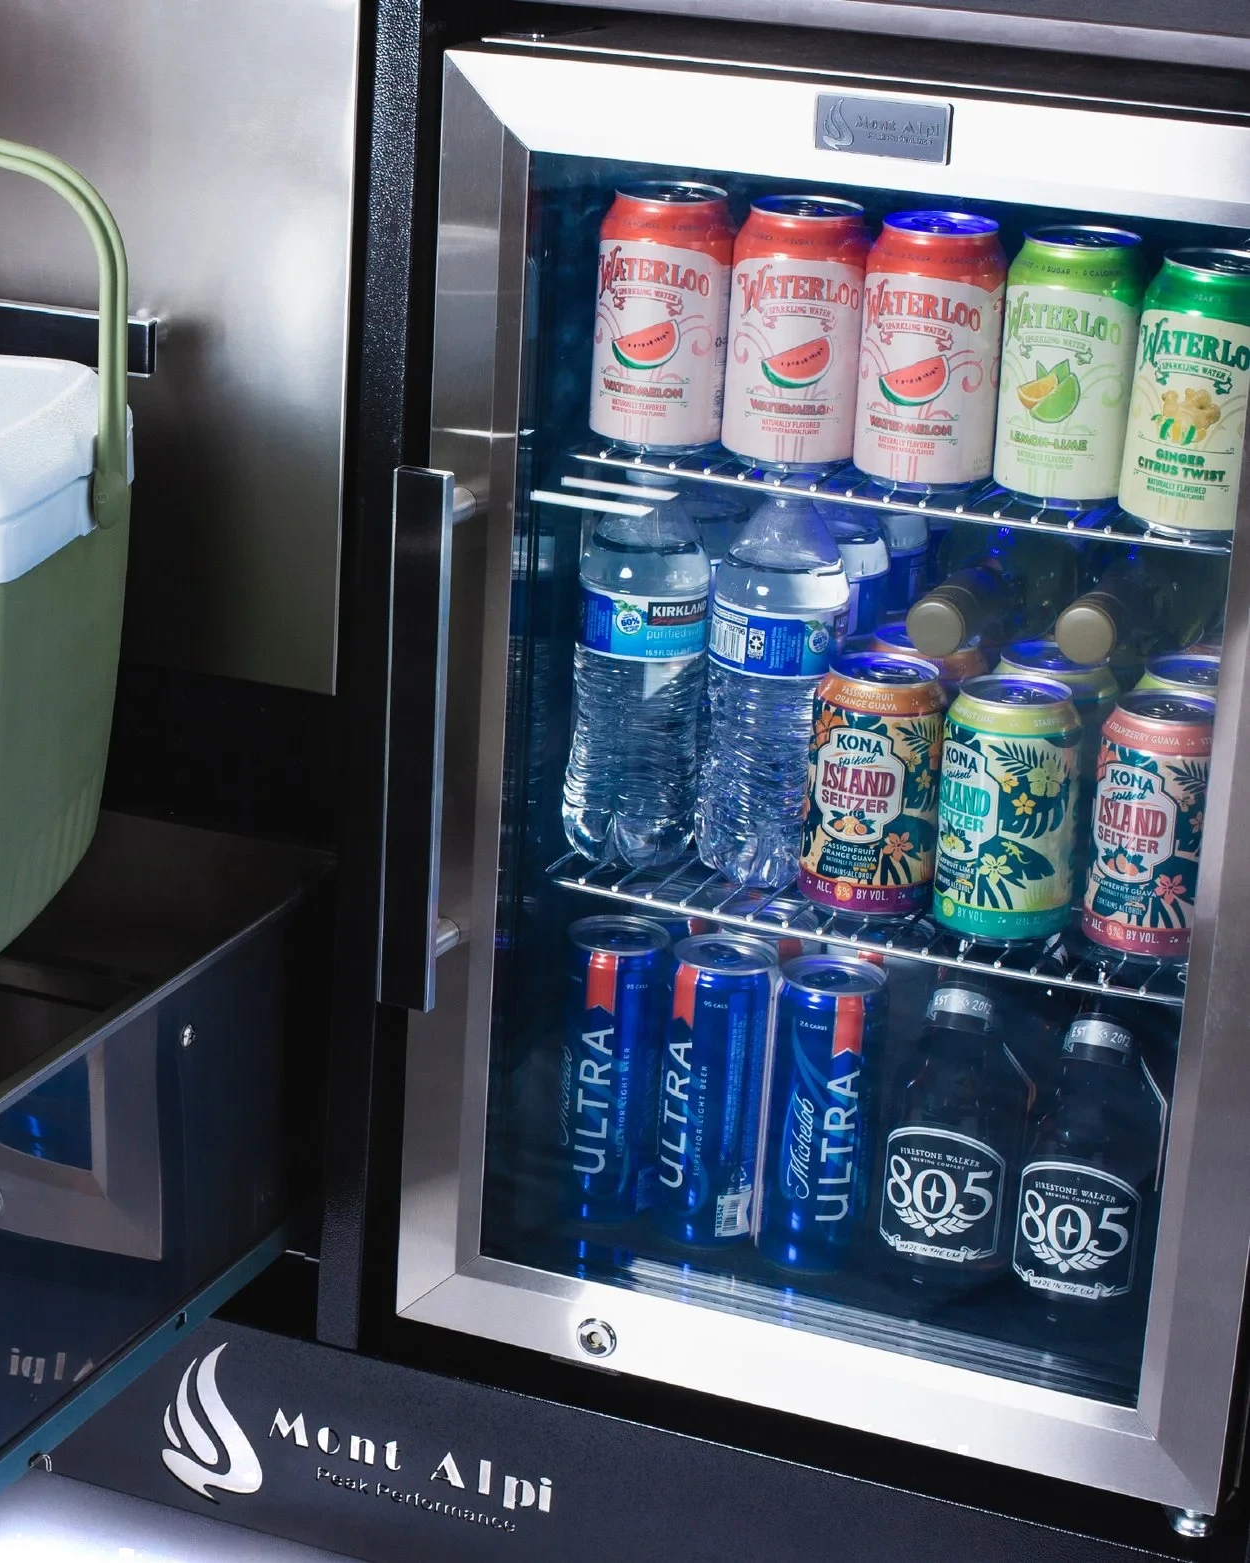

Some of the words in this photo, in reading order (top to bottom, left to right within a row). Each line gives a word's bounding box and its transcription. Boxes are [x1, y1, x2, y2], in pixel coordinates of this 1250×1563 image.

[854, 115, 896, 132] Mont
[902, 121, 940, 137] Alpi
[598, 245, 710, 299] WATERLOO
[1047, 266, 1070, 275] SUGAR
[654, 290, 678, 302] WATER
[737, 264, 860, 318] WATERLOO
[770, 305, 806, 314] SPARKLING
[810, 307, 831, 317] WATER
[865, 279, 981, 333] WATERLOO
[885, 322, 920, 332] SPARKLING
[924, 325, 947, 336] WATER
[1006, 291, 1122, 348] WATERLOO
[1063, 338, 1086, 350] WATER
[1162, 362, 1198, 372] SPARKLING
[1202, 366, 1227, 380] WATER
[603, 378, 683, 398] WATERMELON
[639, 402, 666, 412] FLAVORED
[750, 398, 834, 416] WATERMELON
[762, 418, 792, 428] NATURALLY
[870, 415, 952, 436] WATERMELON
[878, 436, 905, 446] NATURALLY
[906, 440, 935, 449] FLAVORED
[1010, 429, 1088, 452] LEMON-LIME
[1156, 448, 1206, 467] GINGER
[1138, 456, 1178, 476] CITRUS
[1182, 467, 1226, 482] TWIST
[1148, 477, 1176, 490] NATURALLY
[1176, 484, 1206, 495] FLAVORED
[652, 600, 707, 618] KIRKLAND
[646, 628, 686, 640] purified
[834, 694, 866, 708] ORANGE
[868, 701, 898, 712] GUAVA
[841, 686, 895, 702] PASSIONFRUIT
[836, 734, 884, 756] KONA
[1151, 736, 1180, 746] GUAVA
[838, 753, 876, 768] spiked
[946, 746, 978, 774] KONA
[822, 760, 896, 798] ISLAND
[1110, 768, 1155, 794] KONA
[822, 788, 888, 814] SELTZER
[1098, 794, 1168, 838] ISLAND
[824, 840, 876, 856] PASSIONFRUIT
[1098, 824, 1160, 854] SELTZER
[822, 847, 850, 860] ORANGE
[852, 854, 878, 863] GUAVA
[822, 864, 847, 876] CONTAINS
[848, 869, 873, 880] ALCOHOL
[959, 864, 974, 875] LIME
[816, 880, 832, 894] ALC.
[836, 885, 850, 898] 5%
[856, 888, 867, 900] BY
[870, 890, 889, 900] VOL.
[1130, 888, 1157, 898] GUAVA
[958, 906, 966, 918] BY
[968, 910, 987, 923] VOL.
[1096, 896, 1118, 910] CONTAINS
[1118, 904, 1143, 916] ALCOHOL
[1091, 918, 1104, 933] ALC.
[1108, 924, 1122, 938] 5%
[1125, 929, 1137, 941] BY
[1139, 931, 1160, 944] VOL.
[934, 994, 950, 1006] EST
[971, 1000, 993, 1015] 2012
[1072, 1026, 1087, 1038] EST
[1110, 1032, 1131, 1048] 2012
[623, 1047, 631, 1072] BEER
[700, 1066, 708, 1090] BEER
[572, 1028, 614, 1174] ULTRA
[620, 1077, 629, 1104] LIGHT
[658, 1042, 693, 1188] ULTRA
[698, 1095, 706, 1124] LIGHT
[692, 1128, 703, 1176] SUPERIOR
[786, 1092, 815, 1200] Michelob
[814, 1070, 862, 1222] ULTRA
[900, 1147, 943, 1160] FIRESTONE
[946, 1154, 980, 1168] WALKER
[910, 1156, 936, 1166] BREWING
[936, 1161, 965, 1171] COMPANY
[886, 1154, 994, 1221] 805
[1035, 1181, 1078, 1196] FIRESTONE
[1081, 1190, 1116, 1204] WALKER
[1045, 1191, 1070, 1200] BREWING
[1072, 1196, 1100, 1206] COMPANY
[1021, 1189, 1130, 1257] 805
[930, 1247, 945, 1256] THE
[1032, 1278, 1050, 1286] MADE
[1062, 1284, 1078, 1293] THE
[1080, 1288, 1095, 1296] USA
[268, 1407, 401, 1471] Mont
[430, 1450, 552, 1513] Alpi
[316, 1466, 368, 1496] Peak
[376, 1483, 516, 1533] Performance
